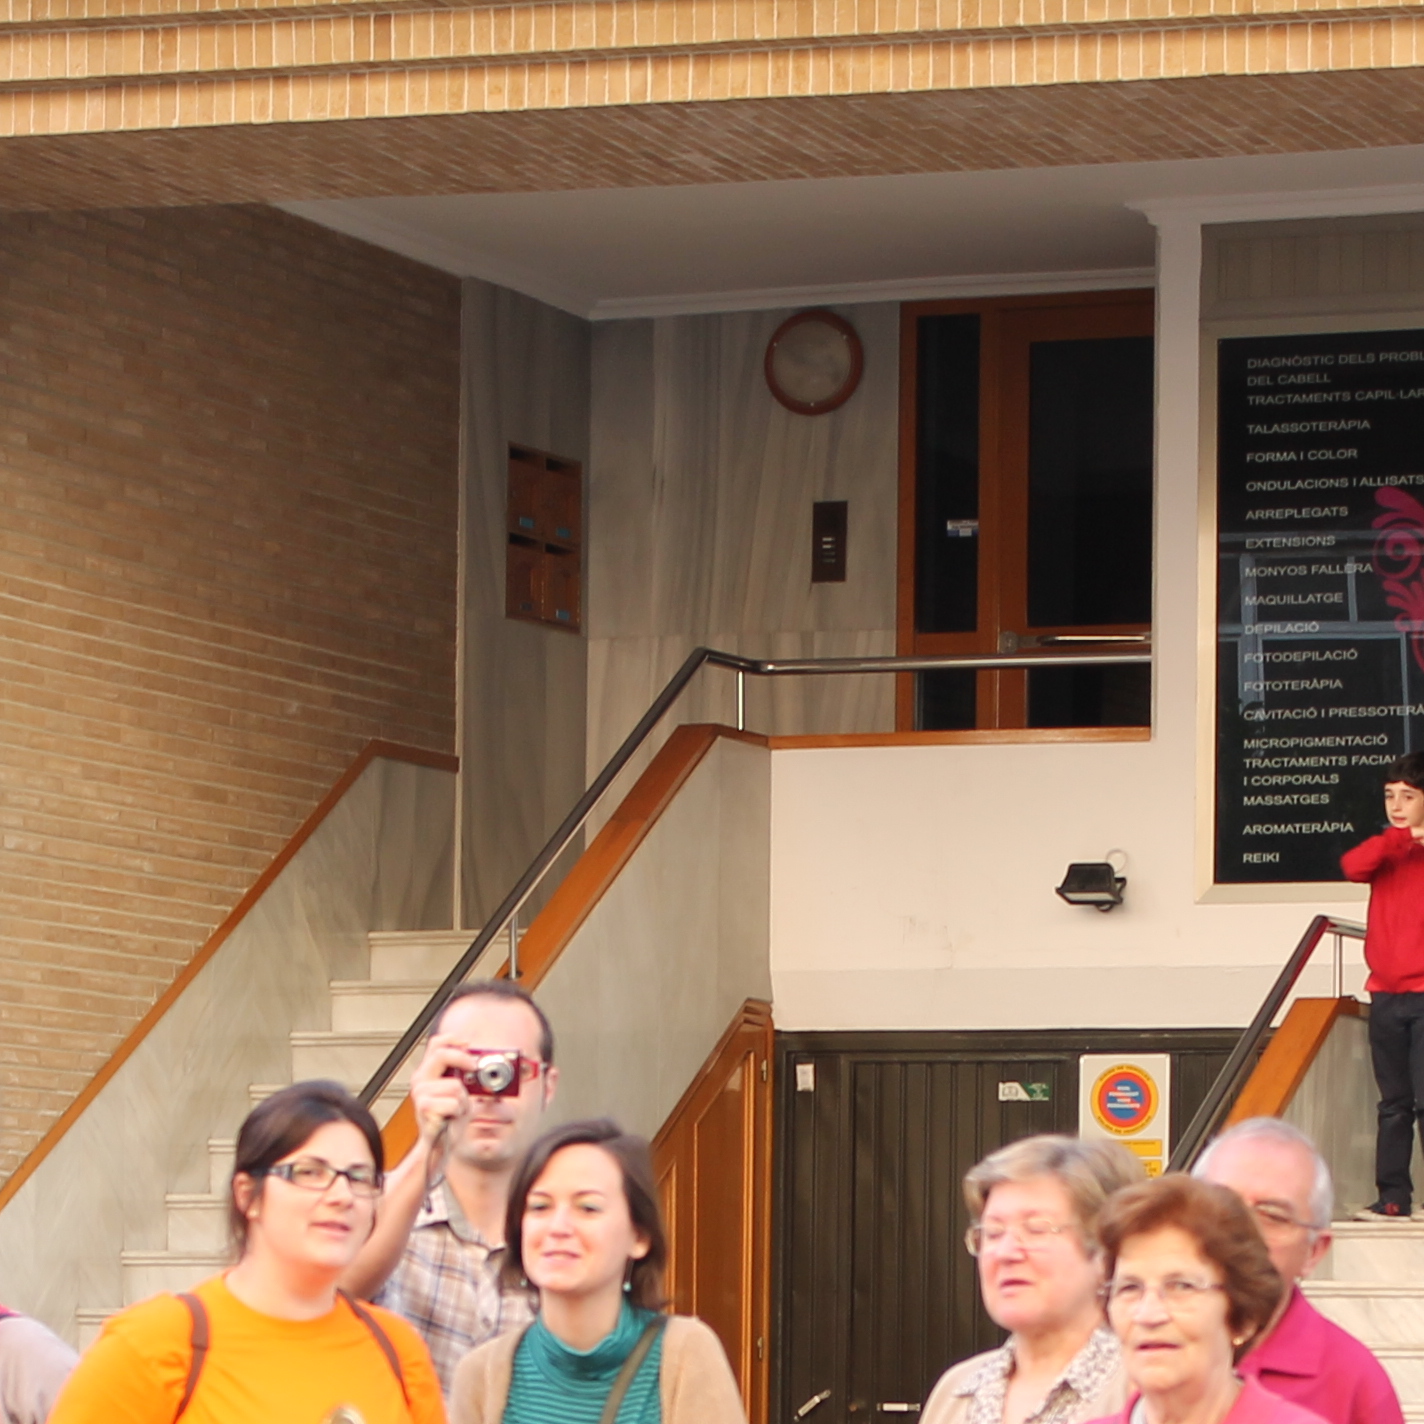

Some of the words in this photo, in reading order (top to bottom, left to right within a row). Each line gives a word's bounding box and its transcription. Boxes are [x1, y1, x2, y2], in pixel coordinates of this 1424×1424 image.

[1338, 352, 1375, 365] DELS
[1247, 375, 1274, 386] DEL
[1277, 373, 1331, 385] CABELL
[1247, 391, 1351, 406] TRACTAMENTS
[1247, 419, 1371, 435] TALASSOTERÀPIA
[1246, 451, 1296, 463] FORMA
[1307, 449, 1358, 460] COLOR
[1246, 477, 1349, 492] ONDULACIONS
[1359, 474, 1424, 486] ALLISATS
[1246, 507, 1348, 520] ARREPLEGATS
[1245, 536, 1336, 549] EXTENSIONS
[1245, 565, 1308, 578] MONYOS
[1311, 563, 1373, 575] FALLERA
[1244, 592, 1343, 606] MAQUILLATGE
[1244, 621, 1320, 635] DEPILACIÓ
[1244, 648, 1358, 664] FOTODEPILACIÓ
[1244, 678, 1343, 692] FOTOTERÀPIA
[1243, 707, 1318, 721] CAVITACIÓ
[1243, 734, 1388, 750] MICROPIGMENTACIÓ
[1244, 755, 1347, 769] TRACTAMENTS
[1251, 773, 1339, 786] CORPORALS
[1243, 794, 1330, 807] MASSATGES
[1243, 821, 1354, 835] AROMATERÀPIA
[1243, 852, 1280, 863] REIKI
